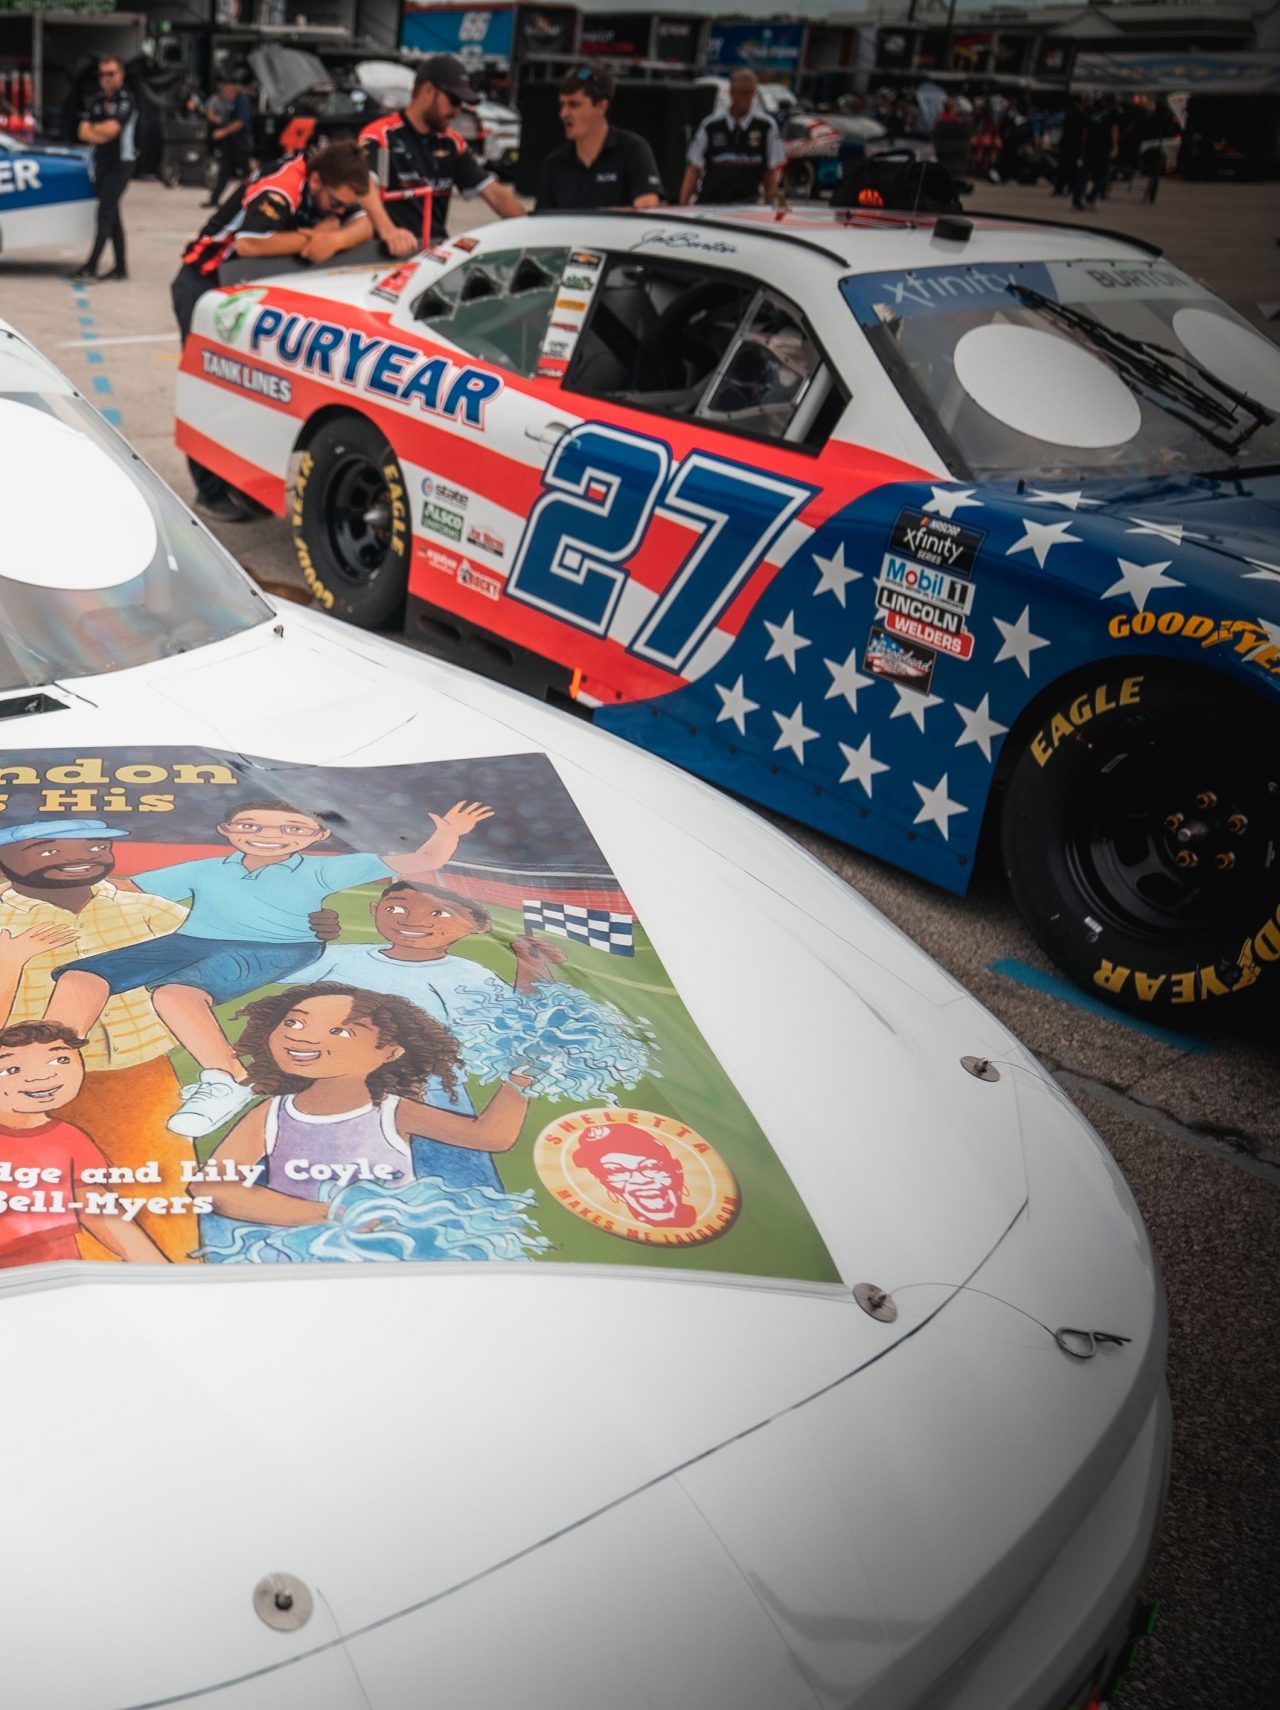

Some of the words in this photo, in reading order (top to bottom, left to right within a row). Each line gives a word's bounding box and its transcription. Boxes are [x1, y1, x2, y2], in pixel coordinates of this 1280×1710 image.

[882, 266, 1017, 308] xfinity
[1086, 268, 1190, 291] BURTON
[201, 350, 243, 384] TANK
[245, 366, 292, 404] LINES
[250, 307, 503, 430] PURYEAR
[382, 464, 407, 557] EAGLE
[503, 420, 823, 676] 27
[902, 526, 963, 565] xfinity
[916, 549, 943, 566] SERIES
[886, 557, 944, 598] Mobil
[880, 589, 959, 633] LINCOLN
[894, 614, 963, 653] WELDERS
[1108, 611, 1280, 674] GOODYE
[1029, 675, 1145, 768] EAGLE
[37, 787, 176, 814] His
[544, 1111, 711, 1154] SHELETTA
[80, 1161, 162, 1185] and
[179, 1158, 265, 1188] Lily
[284, 1157, 393, 1187] Coyle
[556, 1189, 616, 1231] MAKES
[627, 1227, 652, 1244] ME
[663, 1195, 737, 1245] LAUGH.COM
